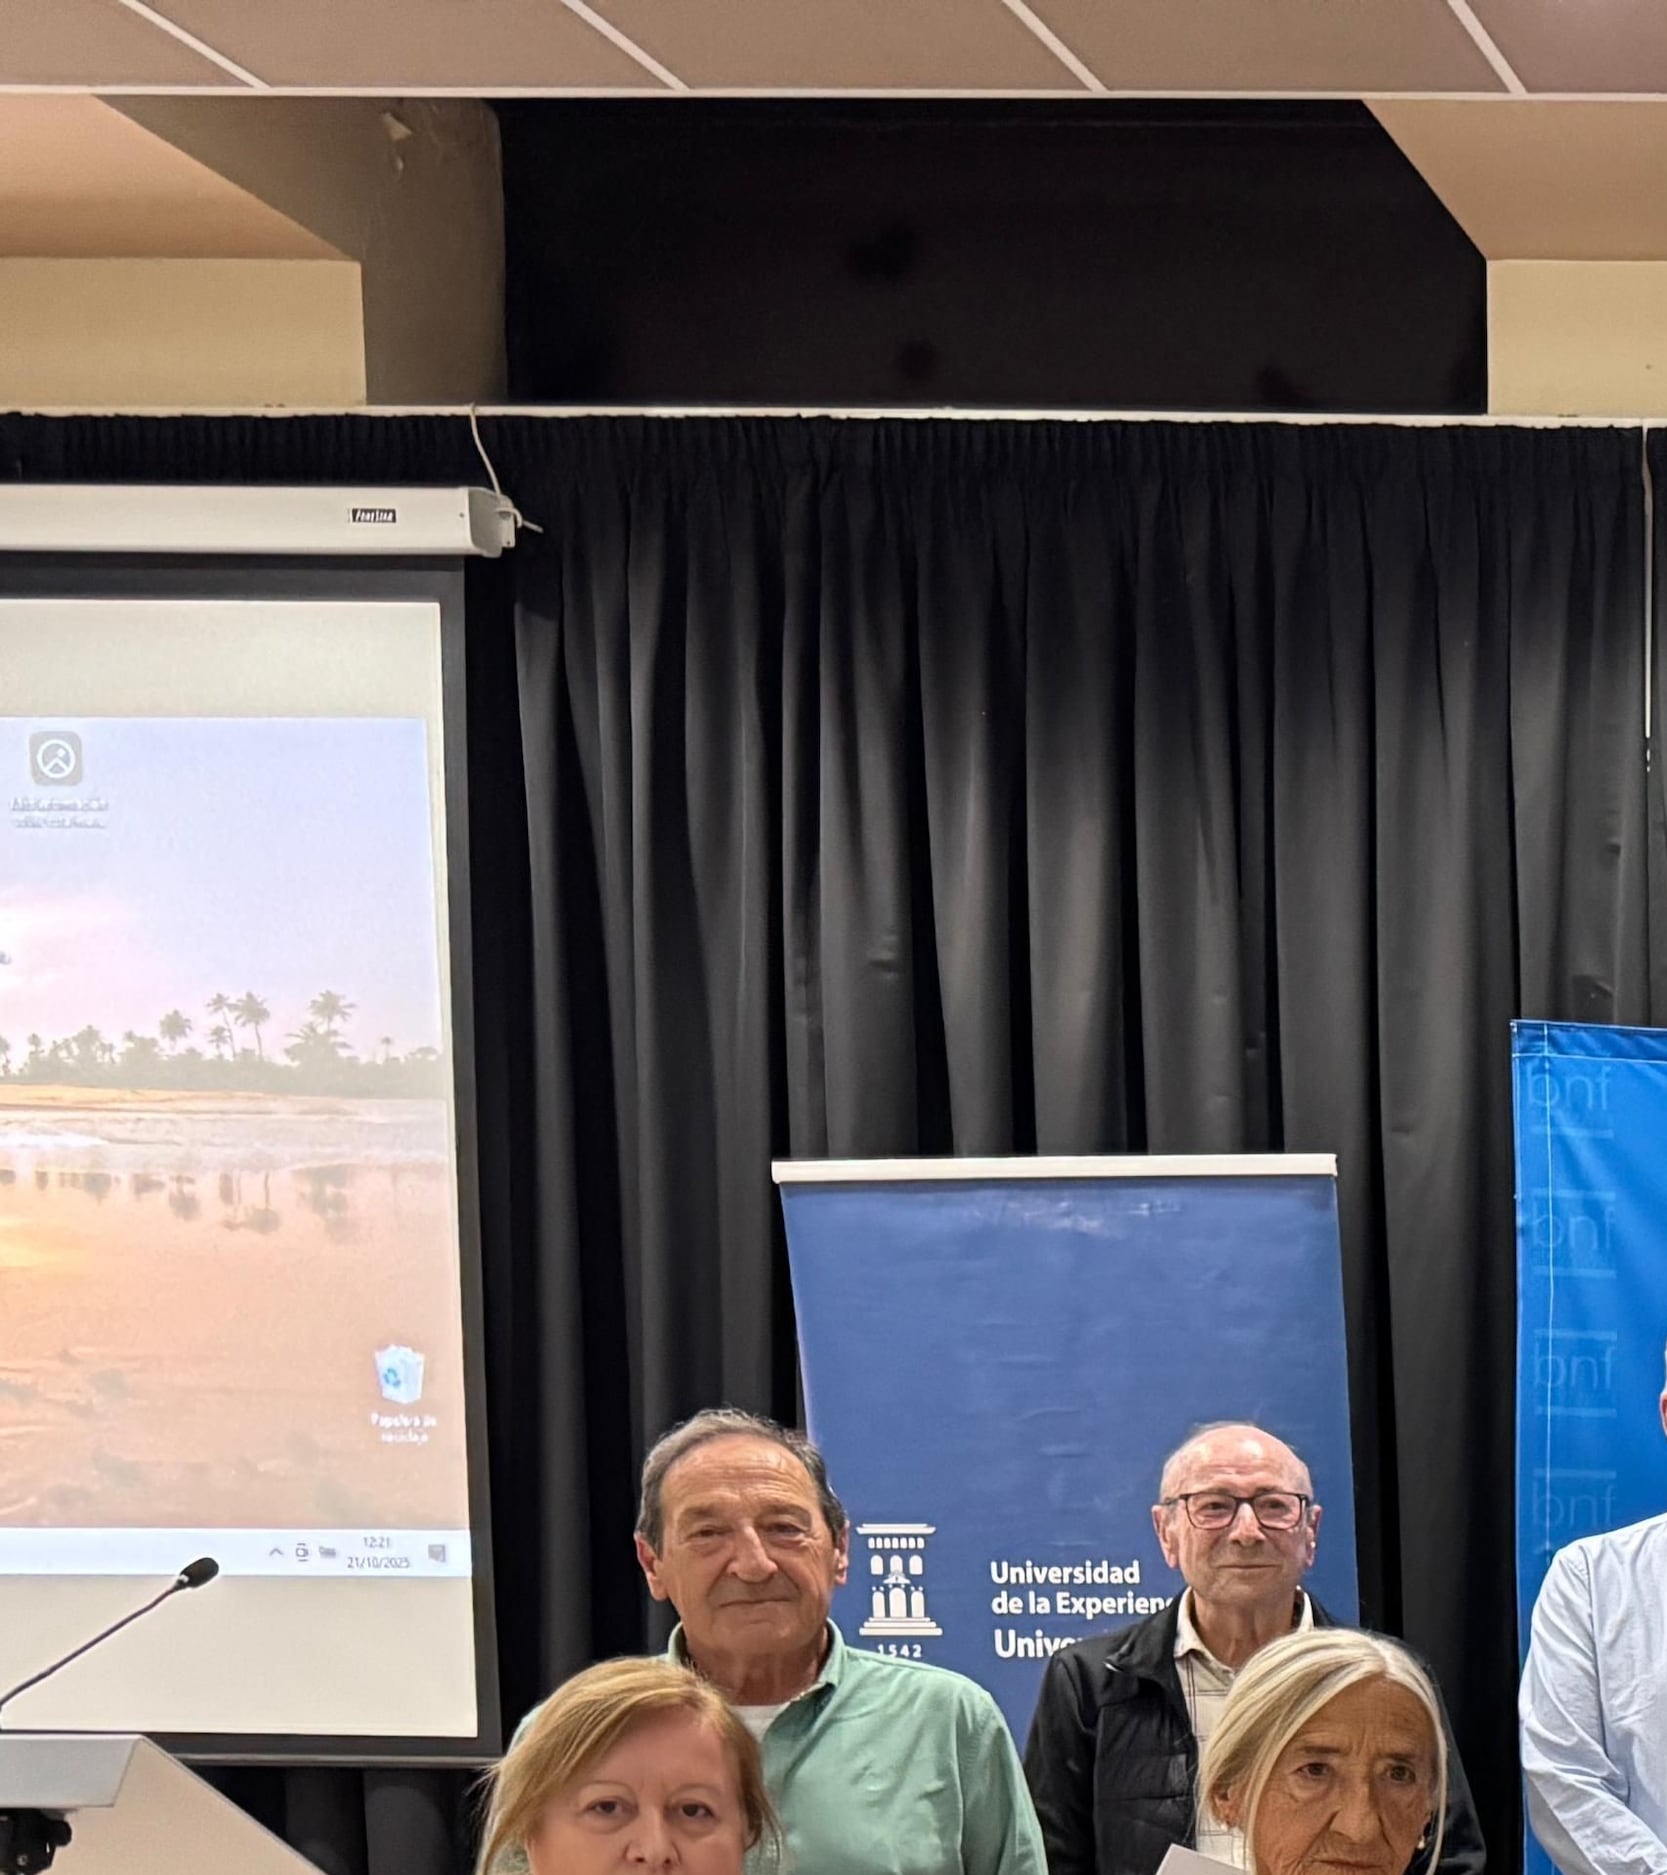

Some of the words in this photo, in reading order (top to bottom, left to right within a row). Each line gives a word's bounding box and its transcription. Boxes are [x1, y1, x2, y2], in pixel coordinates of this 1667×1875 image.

[990, 1559, 1140, 1585] Universidad
[991, 1591, 1023, 1615] de
[1029, 1591, 1051, 1615] la
[878, 1643, 923, 1658] 1542
